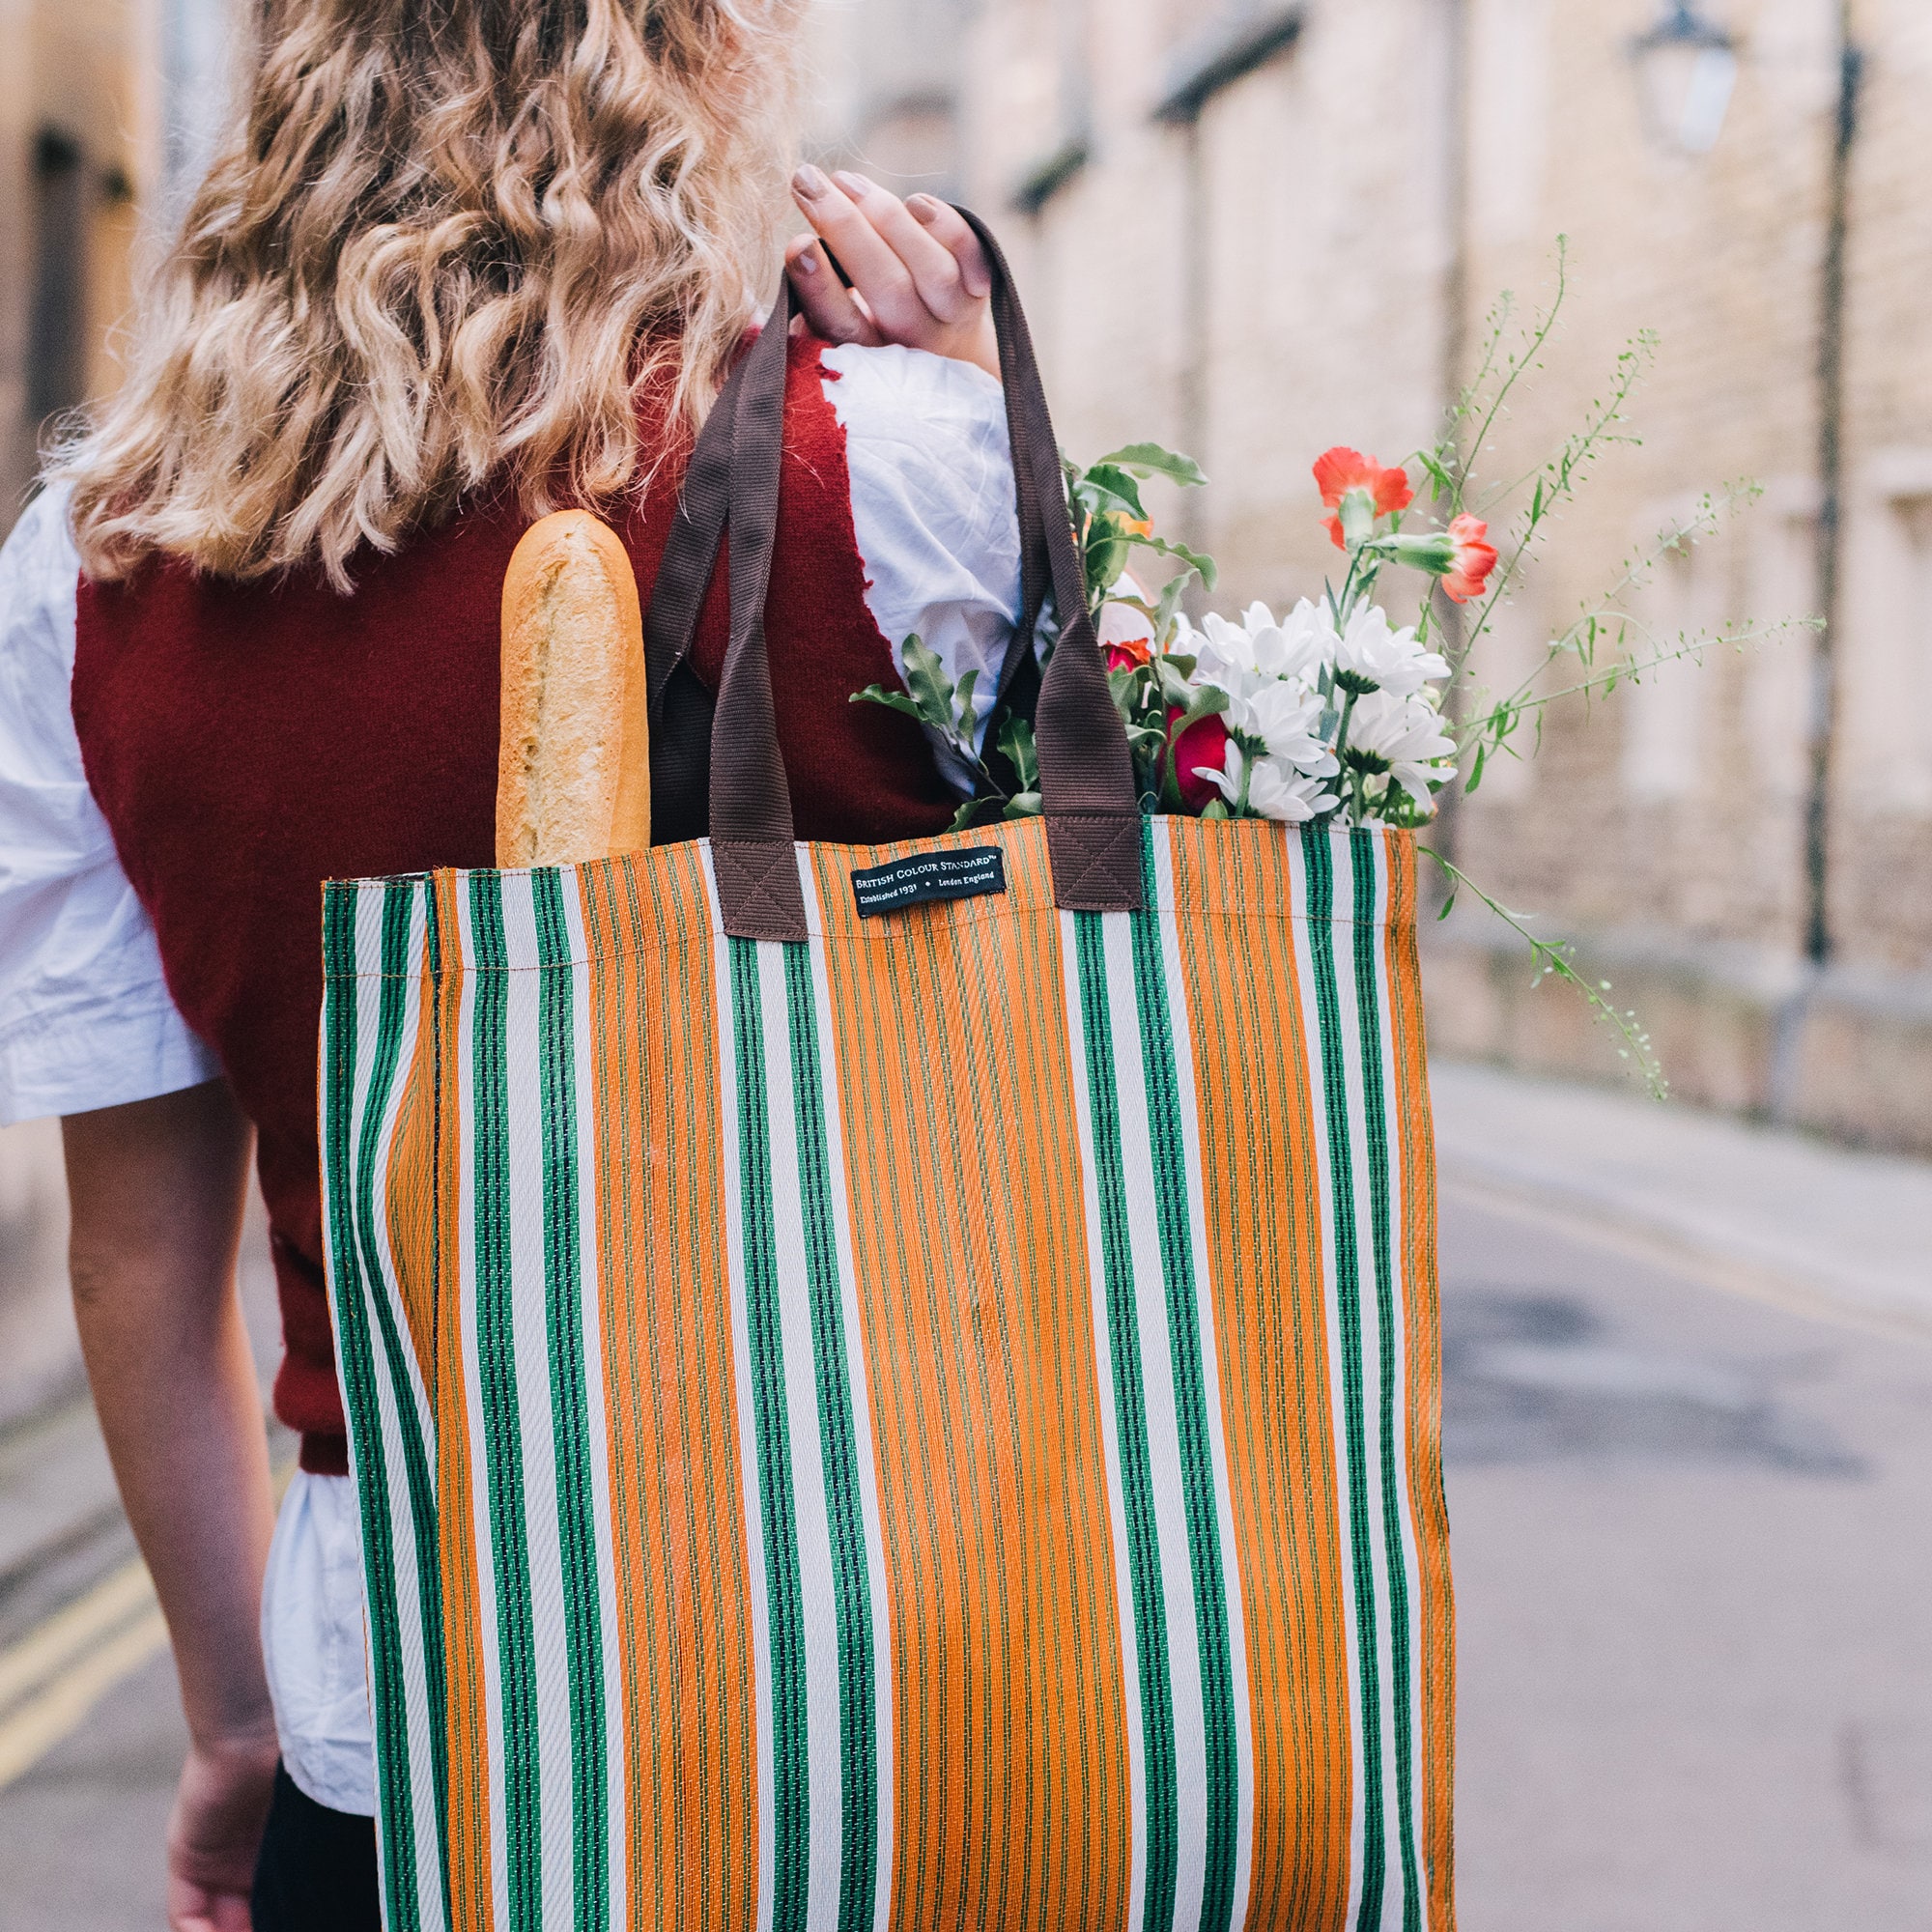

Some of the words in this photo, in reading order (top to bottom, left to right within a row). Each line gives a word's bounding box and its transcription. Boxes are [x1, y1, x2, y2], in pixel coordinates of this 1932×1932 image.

[856, 874, 894, 889] BRITISH
[896, 863, 939, 879] COLOUR
[860, 890, 898, 904] Established
[899, 884, 917, 895] 1931
[939, 876, 962, 887] London
[964, 871, 994, 884] England
